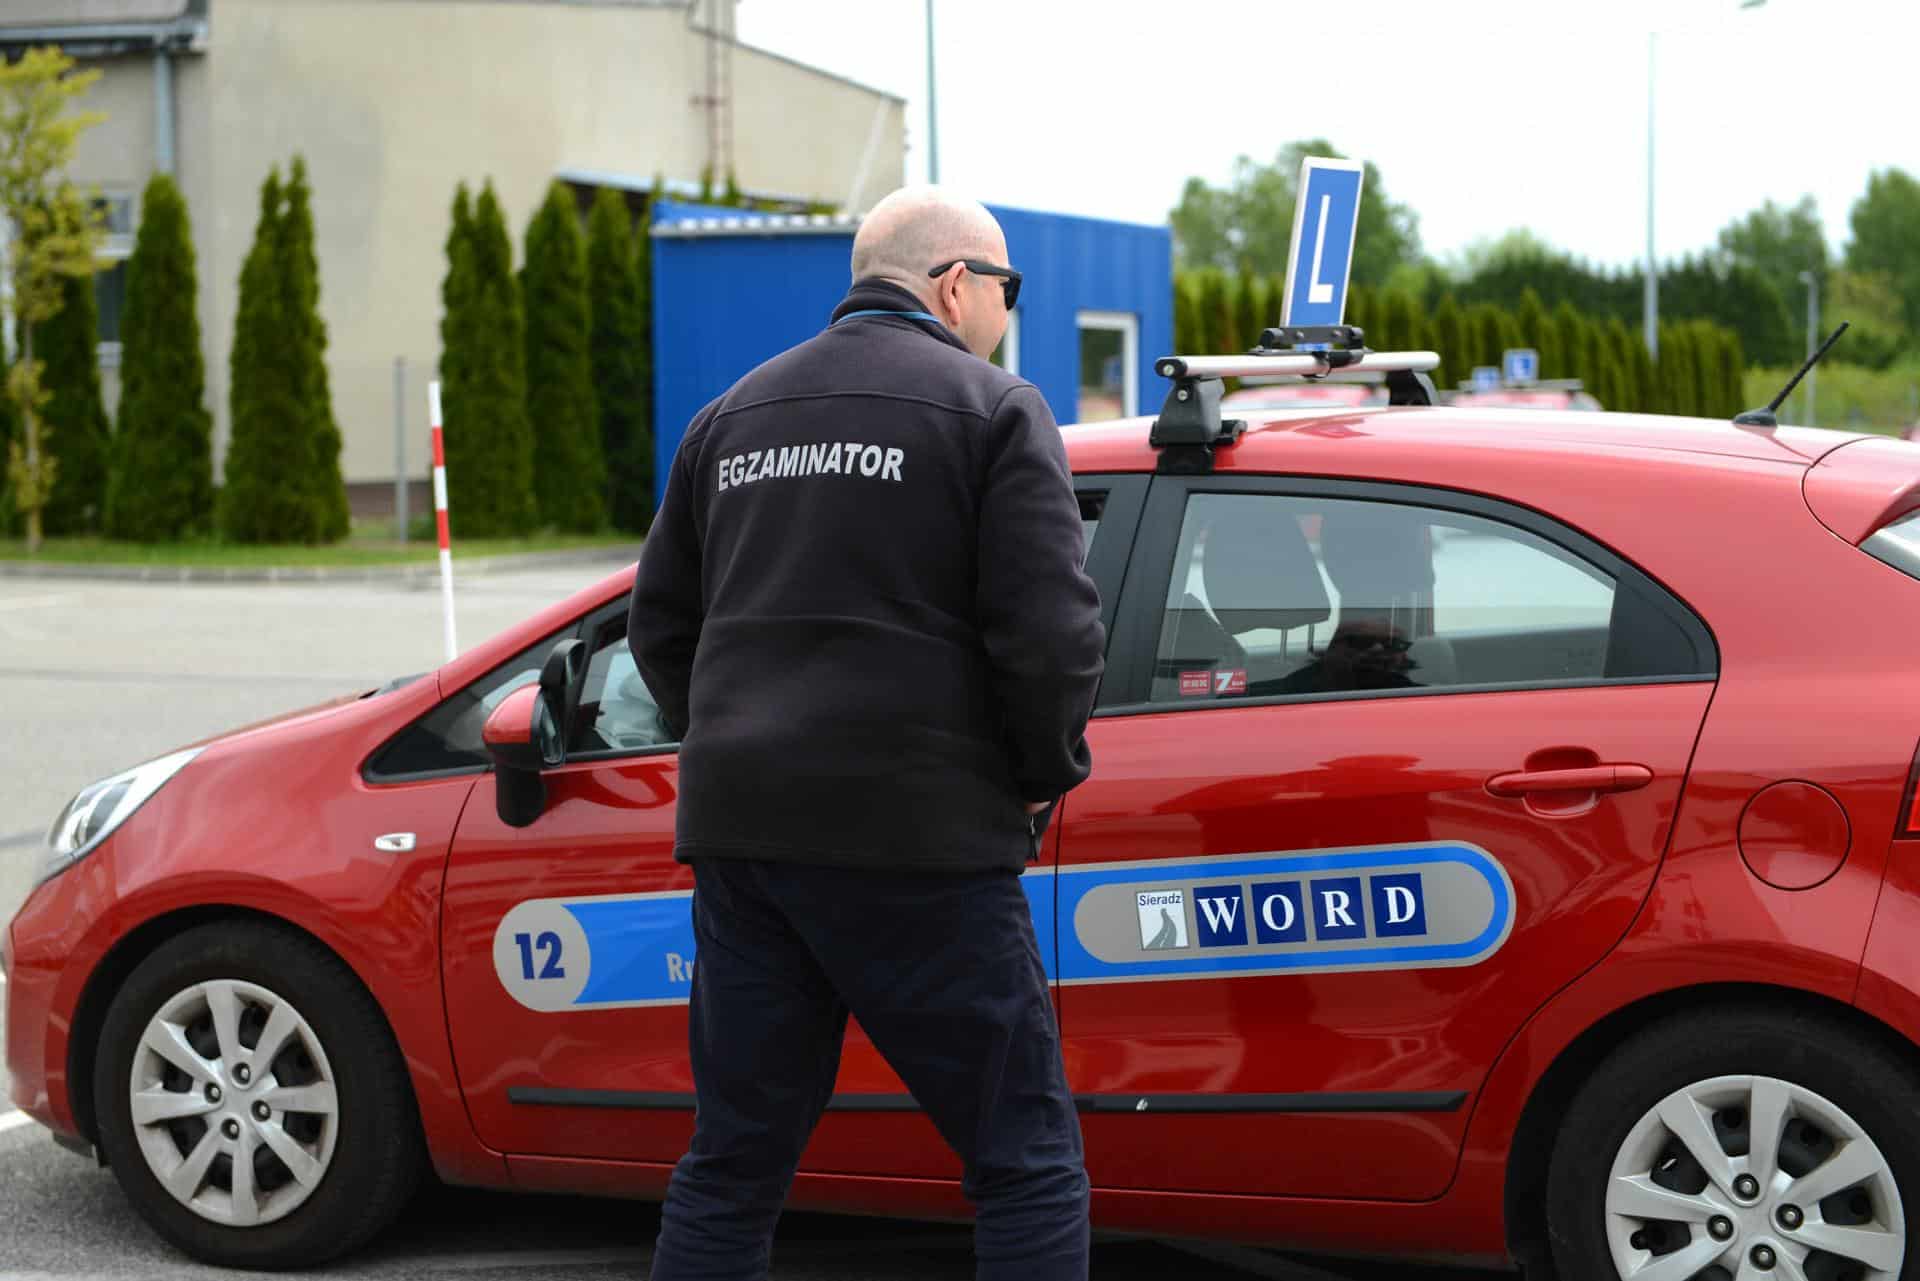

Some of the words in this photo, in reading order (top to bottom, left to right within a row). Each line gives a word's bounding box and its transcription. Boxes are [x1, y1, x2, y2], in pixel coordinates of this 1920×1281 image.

[1308, 194, 1334, 303] L
[718, 442, 904, 492] EGZAMINATOR
[1139, 893, 1181, 906] Sieradz
[1197, 886, 1416, 934] WORD
[515, 931, 565, 979] 12
